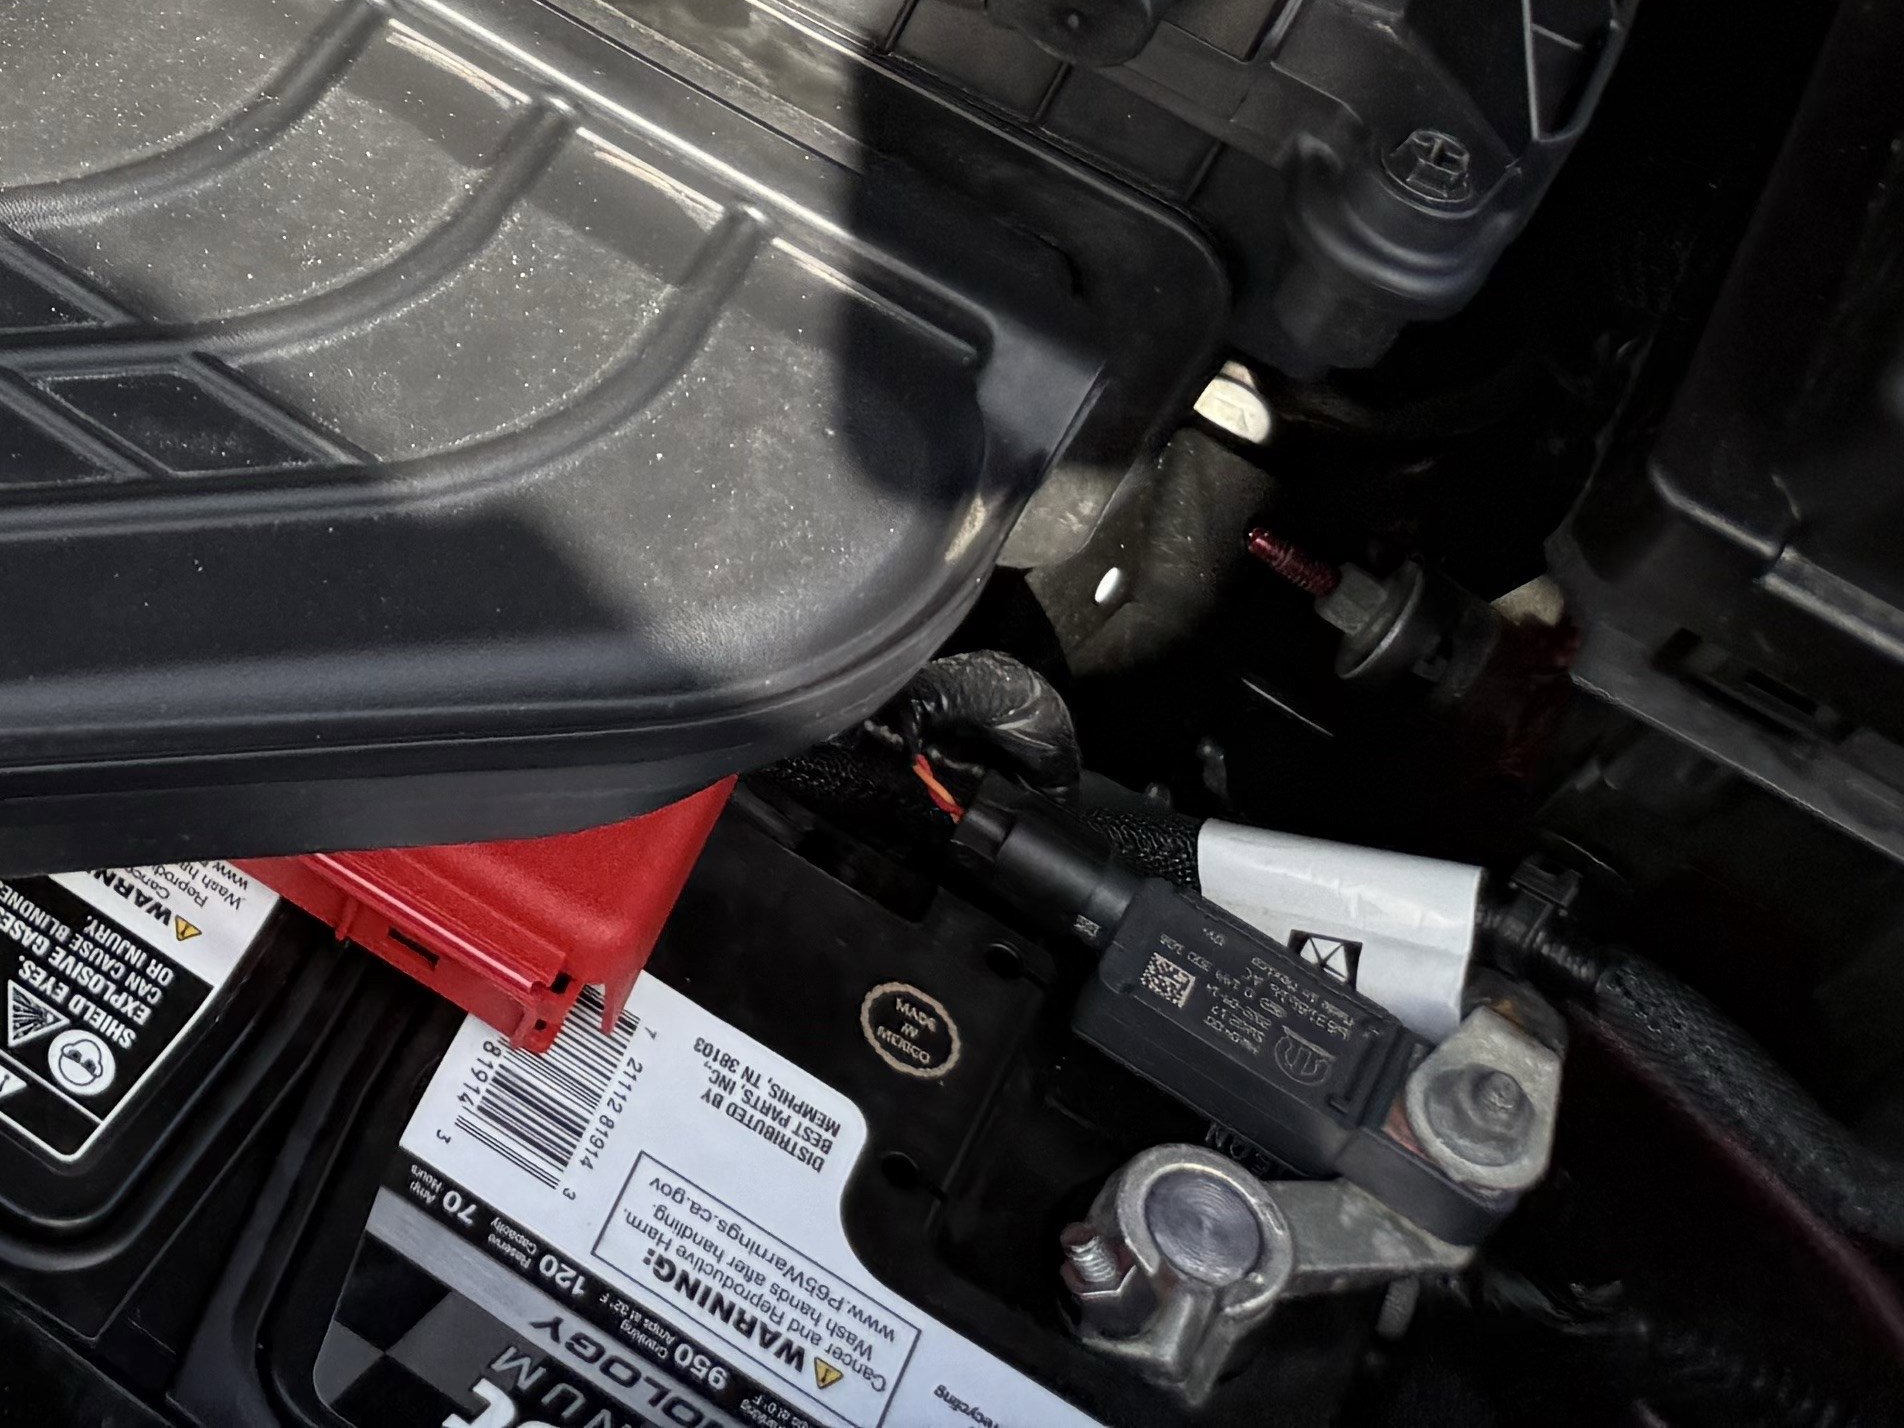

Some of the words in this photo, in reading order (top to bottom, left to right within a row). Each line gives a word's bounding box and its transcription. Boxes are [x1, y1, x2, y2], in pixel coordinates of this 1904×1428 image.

[86, 857, 175, 928] WARN
[148, 859, 209, 908] Reprod
[198, 873, 244, 910] Wash
[66, 930, 127, 981] CAUSE
[79, 912, 148, 969] INJURY.
[10, 952, 71, 1004] EYES.
[45, 942, 153, 1027] EXPLOSIVE
[120, 967, 164, 1005] CAN
[143, 957, 175, 987] OR
[65, 990, 138, 1050] SHIELD
[890, 996, 940, 1033] MADE
[899, 1021, 919, 1039] IN
[689, 1034, 742, 1075] 38103
[874, 1024, 933, 1066] MEXICO
[448, 1037, 507, 1108] 81914
[600, 1055, 649, 1115] 21112
[738, 1064, 766, 1089] TN
[699, 1084, 726, 1109] BY
[733, 1082, 794, 1128] PARTS,
[760, 1076, 844, 1138] MEMPHIS,
[433, 1127, 452, 1144] 3
[572, 1112, 621, 1171] 81914
[722, 1099, 828, 1174] DISTRIBUTED
[787, 1117, 835, 1155] BEST
[405, 1178, 438, 1205] Amp
[406, 1161, 444, 1193] Hours
[437, 1186, 482, 1225] 70
[483, 1230, 534, 1269] Reserve
[487, 1213, 542, 1256] Capacity
[615, 1206, 675, 1252] Harm.
[643, 1199, 729, 1263] handling.
[534, 1250, 592, 1298] 120
[646, 1171, 900, 1344] www.P65Warnings.ca.gov
[724, 1253, 768, 1290] after
[670, 1241, 789, 1326] Reproductive
[765, 1280, 824, 1325] hands
[632, 1245, 814, 1374] WARNING:
[639, 1313, 678, 1345] Amps
[785, 1316, 823, 1348] and
[819, 1315, 879, 1362] Wash
[525, 1304, 726, 1428] OLOGY
[668, 1339, 734, 1392] 950
[820, 1339, 893, 1395] Cancer
